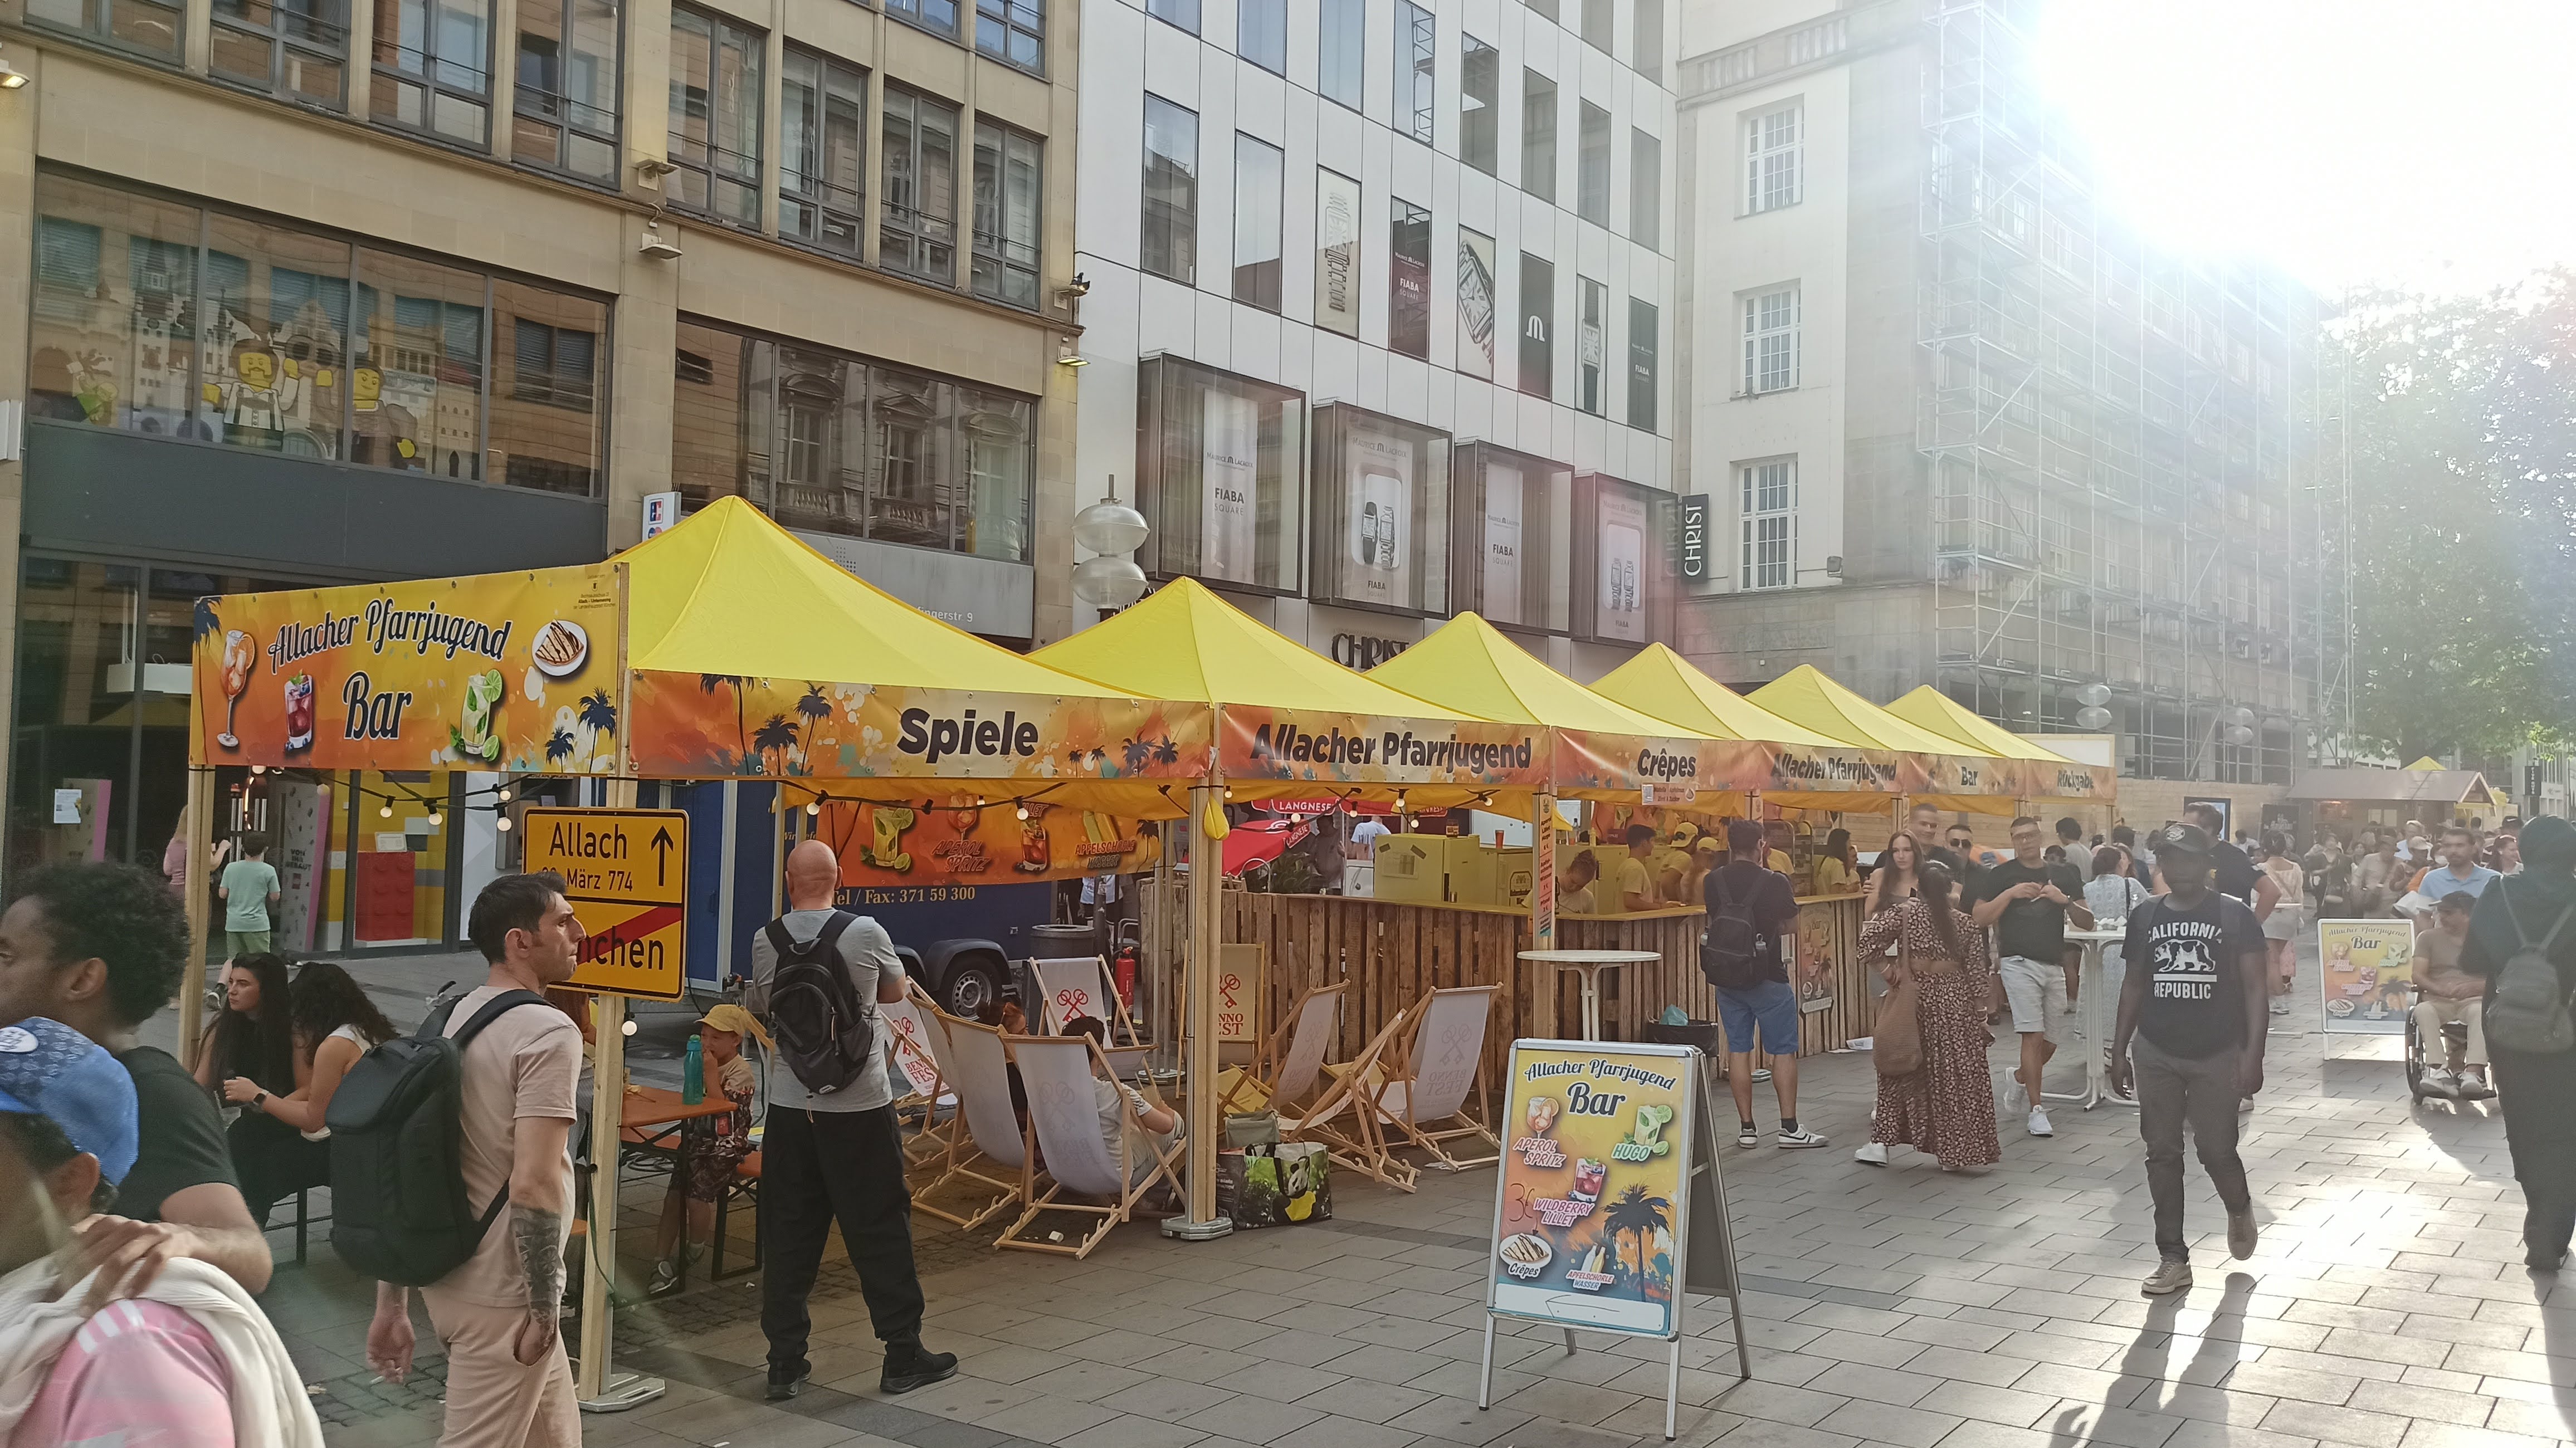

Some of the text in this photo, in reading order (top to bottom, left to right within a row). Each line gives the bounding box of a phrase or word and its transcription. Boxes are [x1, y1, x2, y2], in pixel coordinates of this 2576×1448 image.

[1399, 278, 1419, 292] FIABA
[1399, 288, 1418, 301] SQUARE
[1353, 437, 1376, 451] MAURICE
[1385, 446, 1407, 458] LACROIX
[1215, 487, 1245, 504] FIABA
[1214, 503, 1243, 516] SQUARE
[1684, 503, 1702, 576] CHRIST
[1493, 544, 1514, 557] FIABA
[1368, 580, 1385, 590] FIABA
[967, 613, 973, 622] 9
[268, 598, 513, 674] Allacher Pfarrjugend
[342, 671, 412, 740] Bar
[896, 707, 1038, 764] Spiele
[1250, 723, 1531, 774] Allacher Pfarrjugend
[1638, 748, 1696, 782] Crêpes
[1770, 753, 1897, 785] Allacher Pfarrjugend
[1961, 766, 1978, 786] Bar
[2057, 770, 2094, 791] Rückgabe
[549, 821, 627, 859] Allach
[931, 840, 984, 857] APEROL
[1075, 839, 1136, 855] APFELSCHORLE
[945, 855, 991, 872] SPRITZ
[567, 868, 633, 892] März 774
[865, 889, 895, 904] Fax:
[900, 889, 925, 903] 371
[930, 888, 947, 902] 59
[951, 887, 976, 901] 300
[2361, 926, 2407, 937] Pfarrjugend
[577, 925, 664, 971] nchen
[2351, 936, 2382, 950] Bar
[2154, 982, 2211, 999] REPUBLIC
[1218, 1013, 1243, 1023] NNO
[910, 1067, 935, 1084] FES
[1524, 1059, 1676, 1090] Allacher Pfarrjugend
[1567, 1082, 1627, 1117] Bar
[1514, 1137, 1559, 1153] APEROL
[1611, 1143, 1651, 1161] HUGO
[1524, 1152, 1567, 1167] SPRITZ
[1533, 1197, 1595, 1216] WILDBERRY
[1541, 1211, 1577, 1227] LILLET
[1509, 1262, 1539, 1278] Crêpes
[1567, 1270, 1614, 1284] APFELSCHORLE
[1574, 1279, 1601, 1289] WASSER
